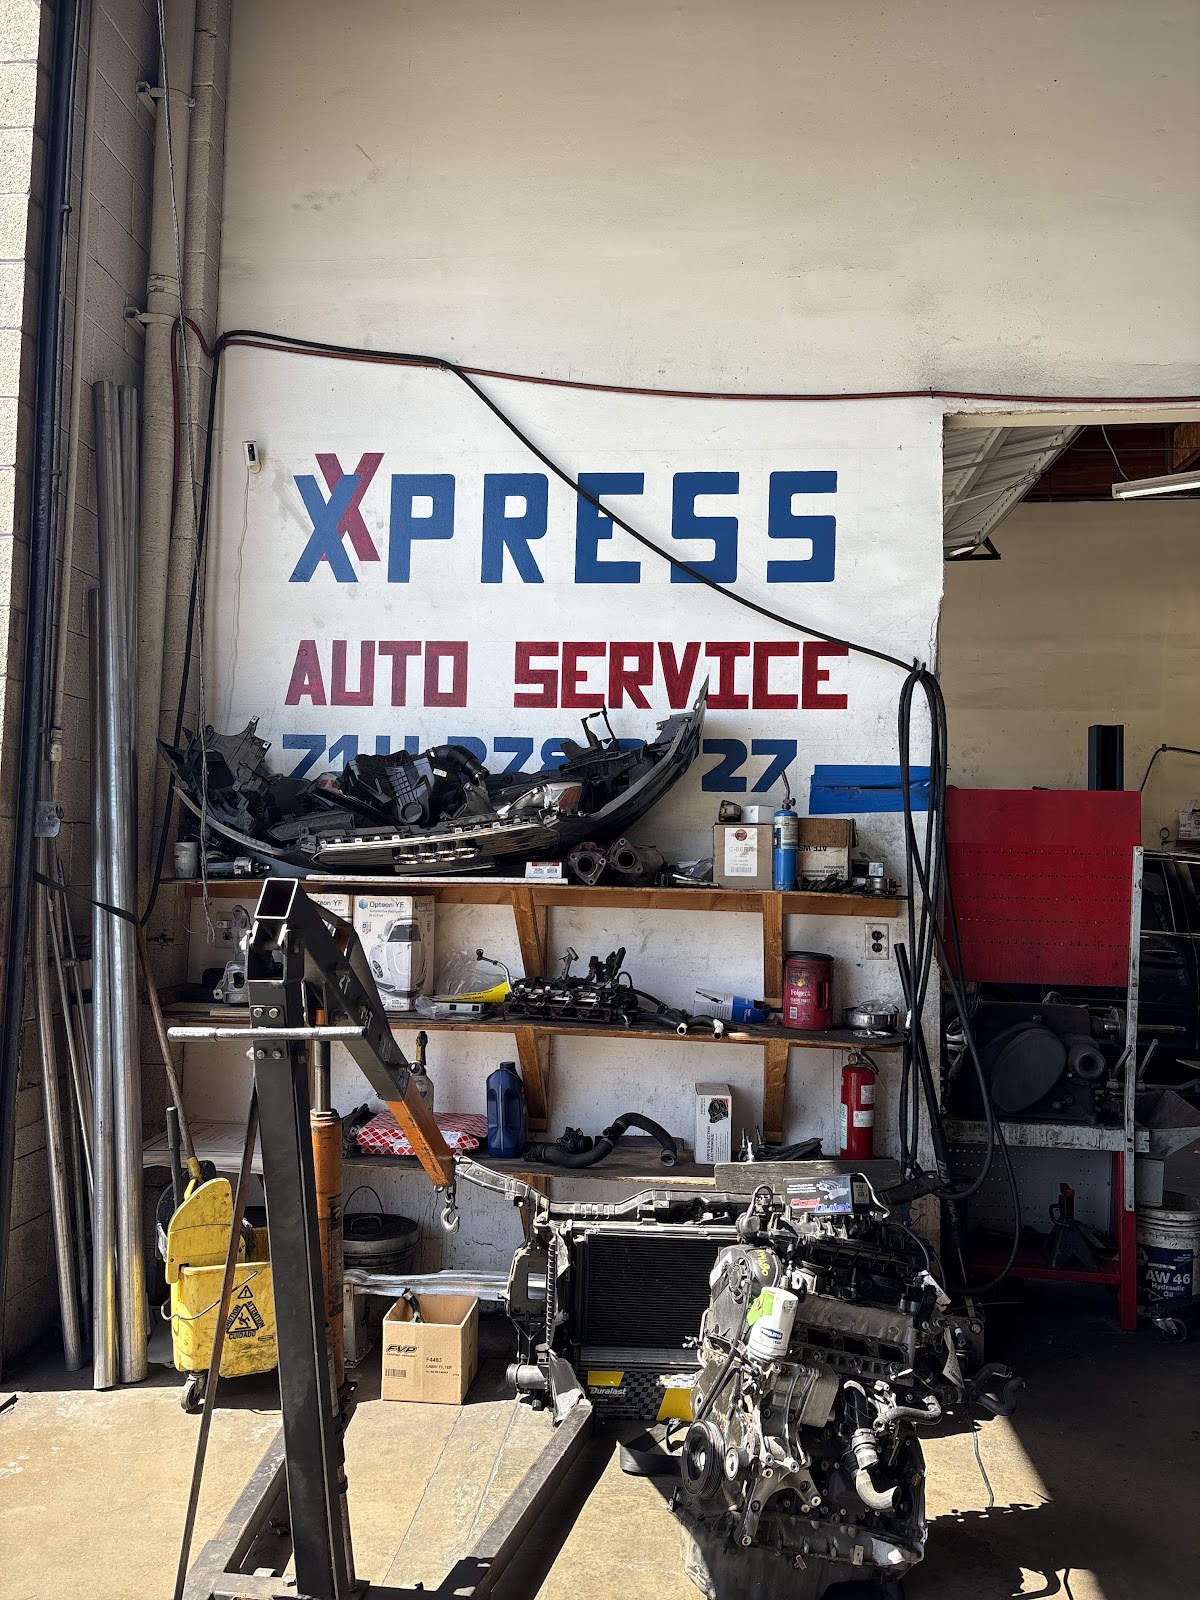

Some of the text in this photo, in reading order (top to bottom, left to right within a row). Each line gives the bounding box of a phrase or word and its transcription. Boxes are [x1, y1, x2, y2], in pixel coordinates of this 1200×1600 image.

[289, 453, 838, 583] XPRESS
[284, 640, 849, 710] AUTO SERVICE
[1145, 1270, 1191, 1285] AW 46
[1151, 1282, 1185, 1291] Hydraulic
[228, 1330, 257, 1340] CUIDADO
[386, 1344, 418, 1354] FVP
[589, 1386, 627, 1395] Duralast
